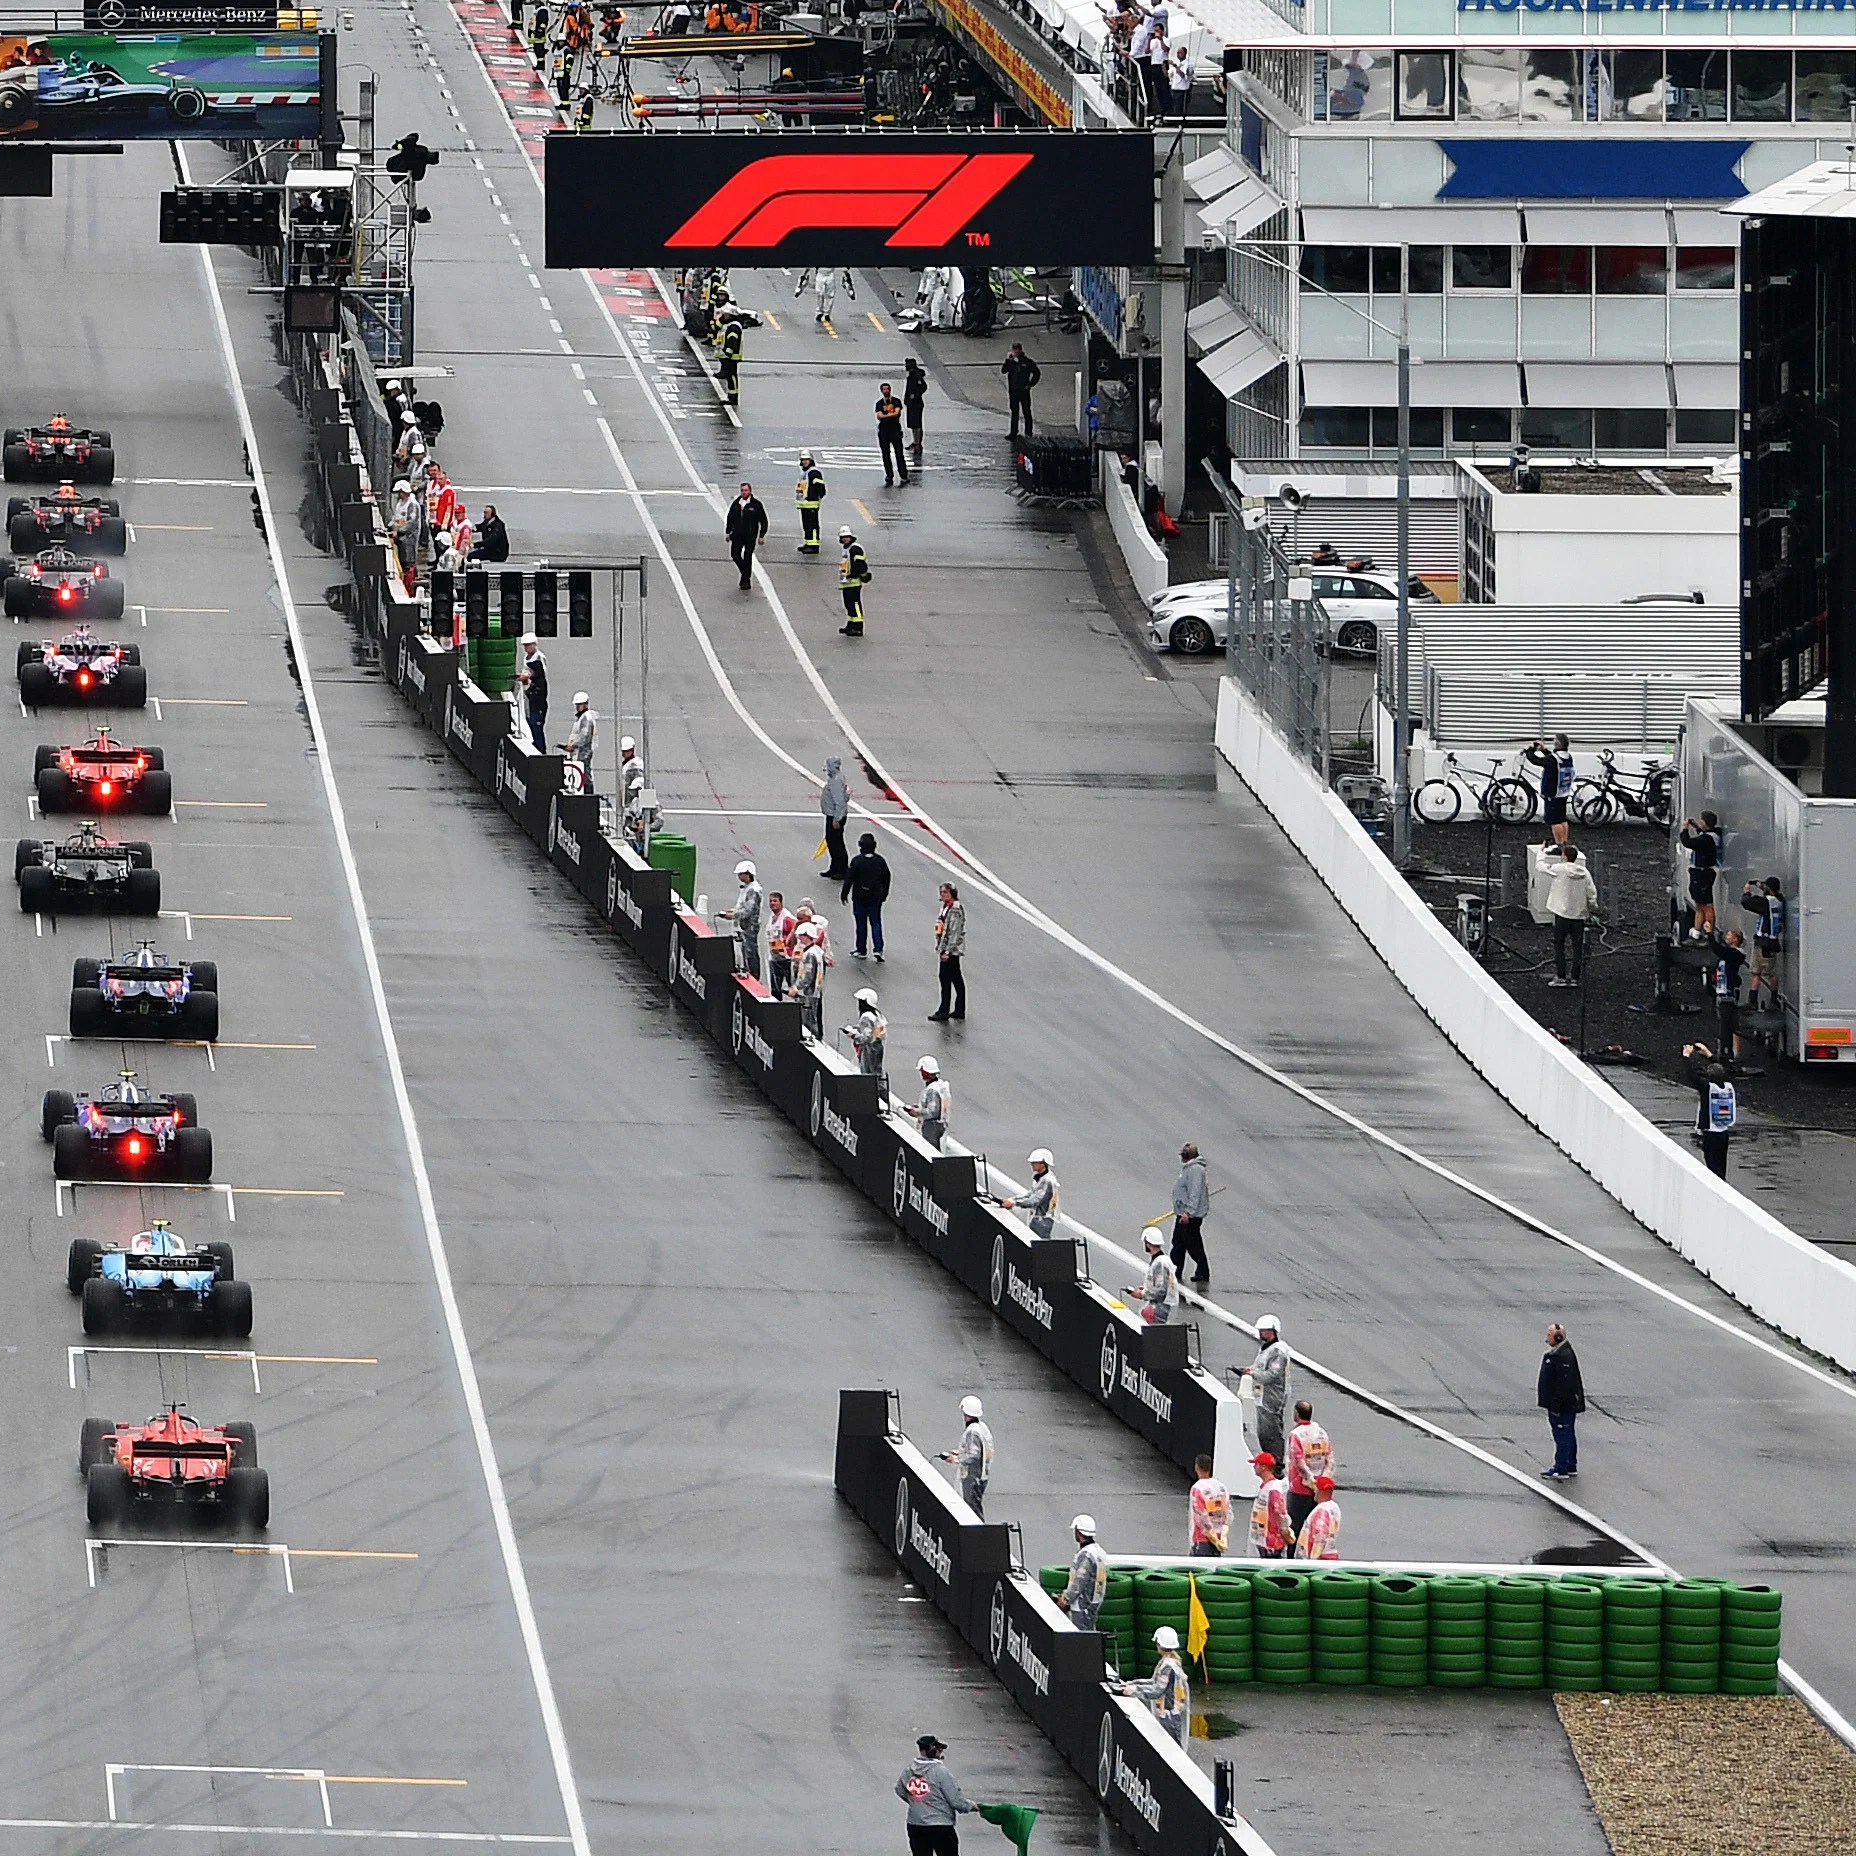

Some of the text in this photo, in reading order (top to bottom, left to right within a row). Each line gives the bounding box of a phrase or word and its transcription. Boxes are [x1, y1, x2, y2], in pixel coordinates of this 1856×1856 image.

[140, 5, 267, 23] Mercedes-Benz
[160, 1259, 197, 1267] ORLEN
[1007, 1262, 1053, 1332] Mercedes-Benz
[1137, 1367, 1174, 1423] Motorsport
[910, 1507, 952, 1586] Mercedes-Benz
